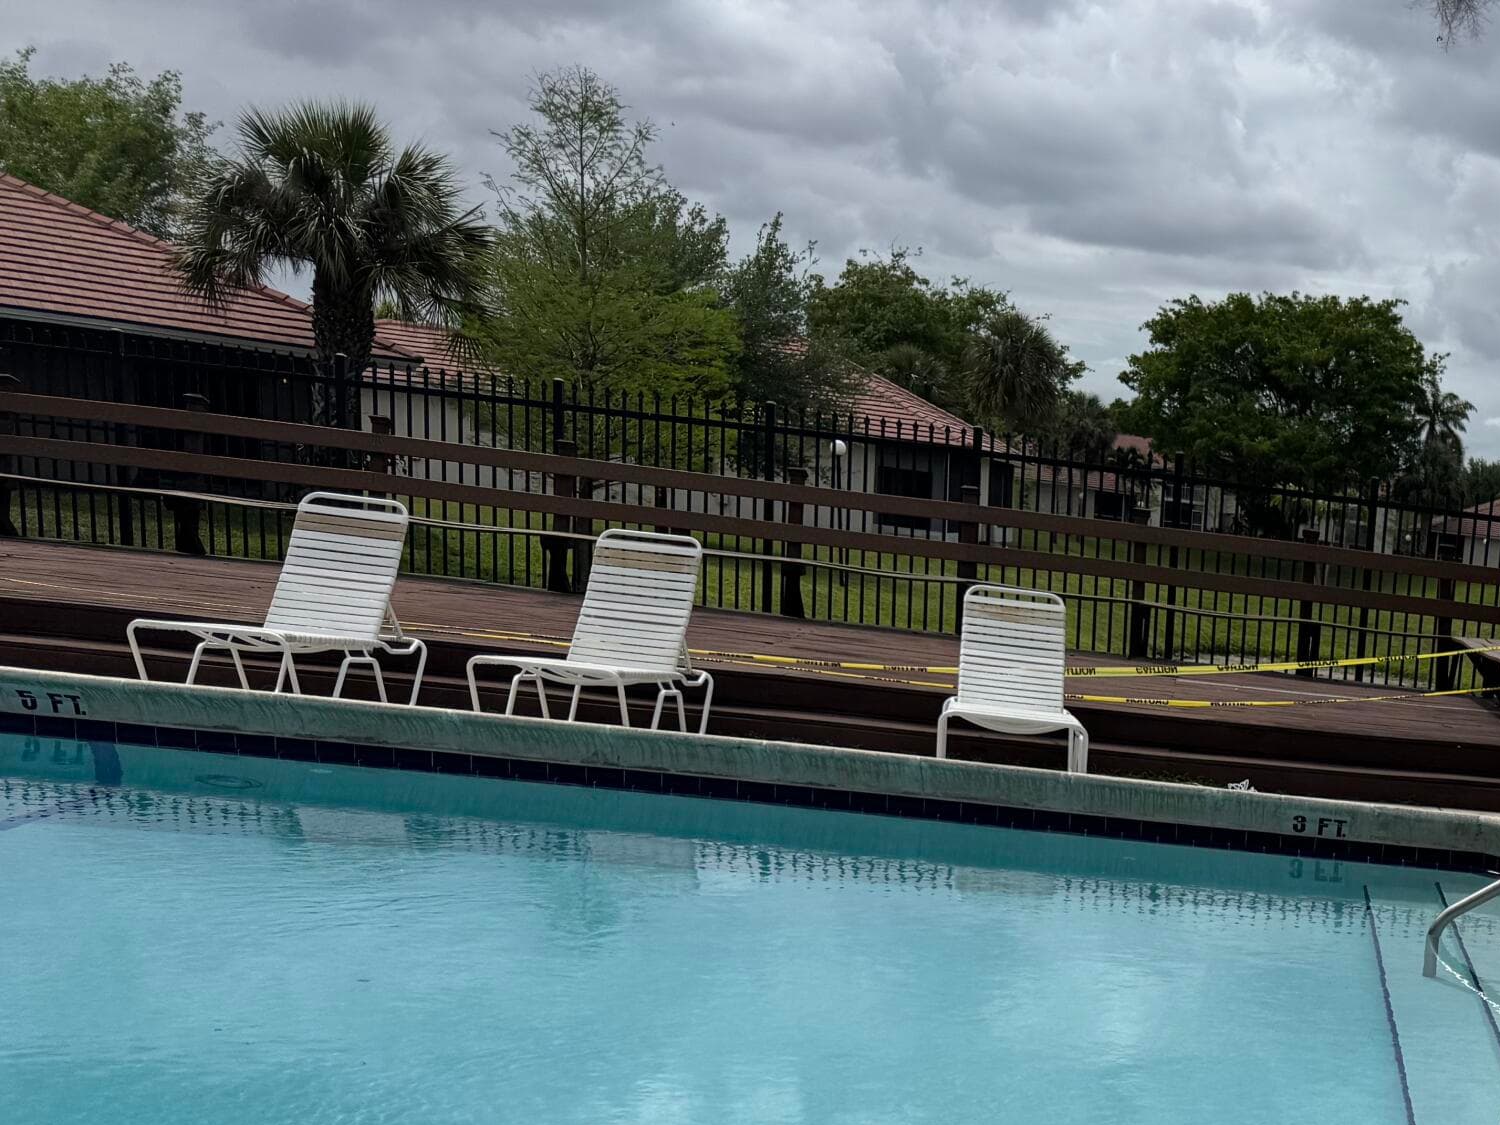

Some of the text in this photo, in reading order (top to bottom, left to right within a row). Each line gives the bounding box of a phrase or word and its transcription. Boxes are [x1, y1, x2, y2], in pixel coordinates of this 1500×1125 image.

[15, 689, 87, 716] 5 FT.
[1292, 815, 1348, 838] 3 FT.
